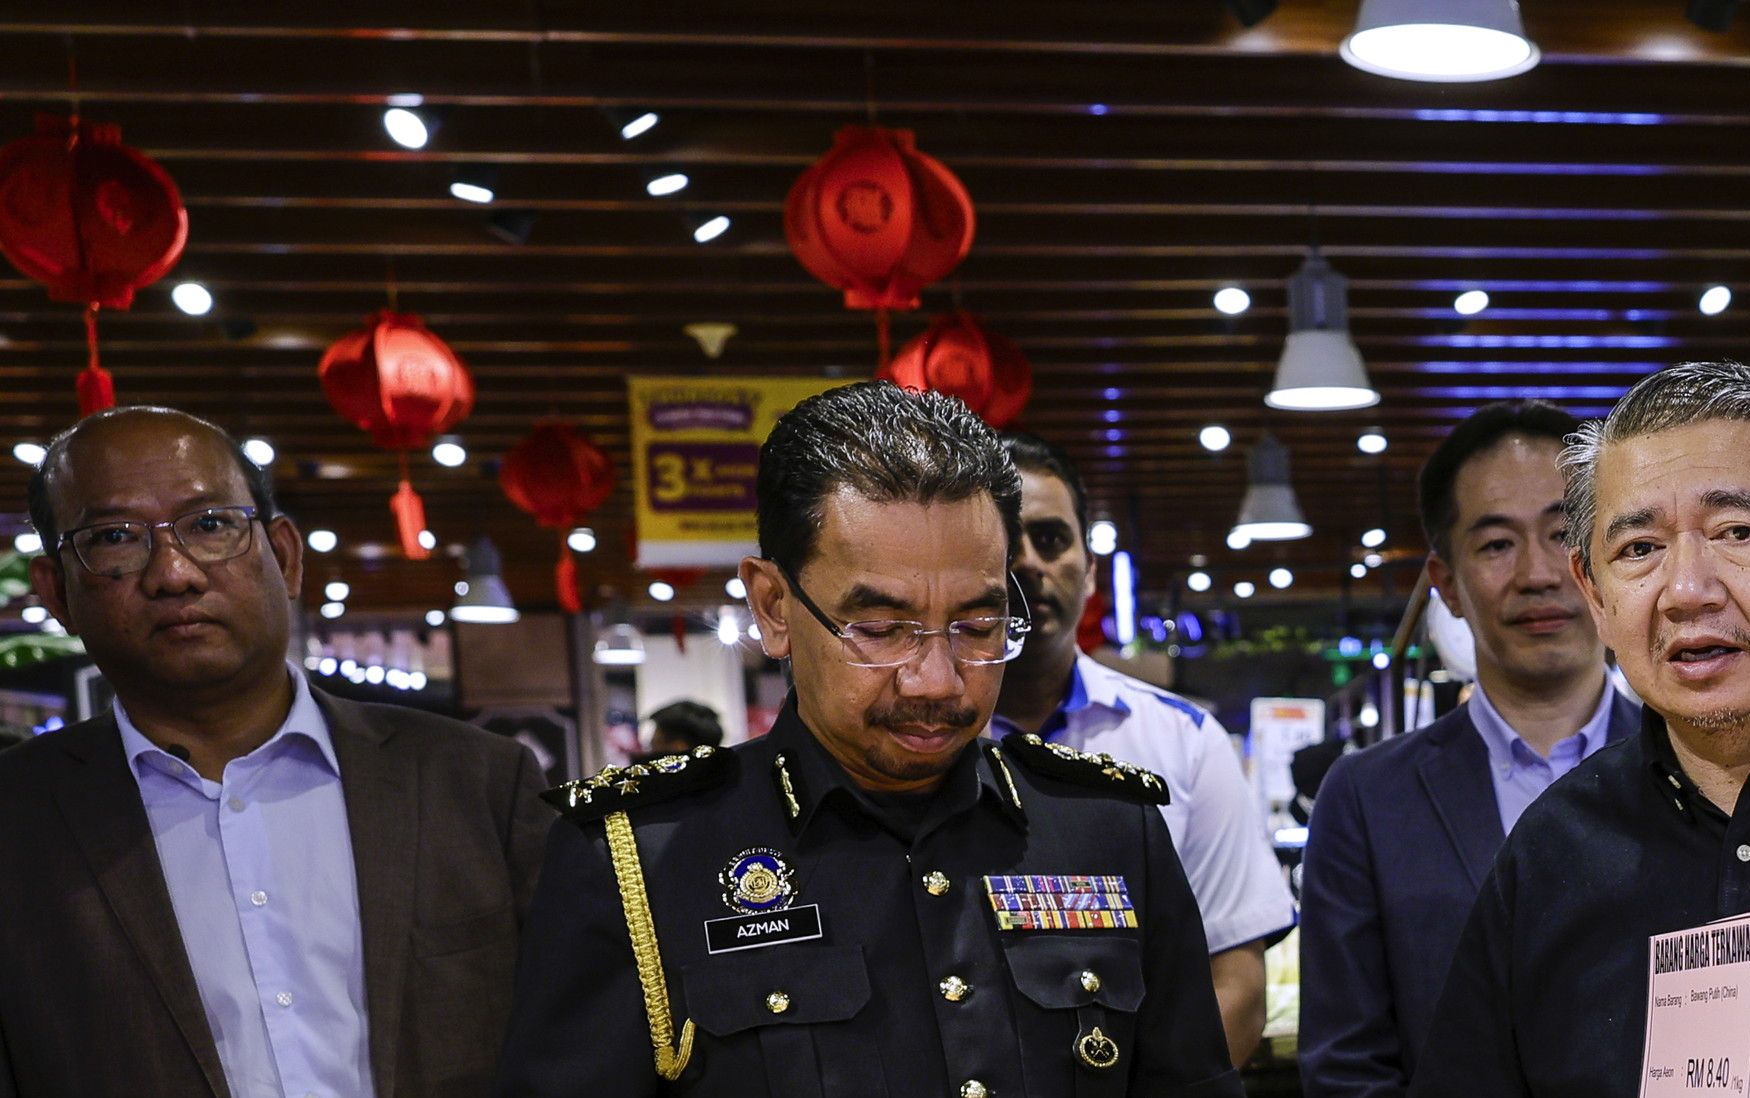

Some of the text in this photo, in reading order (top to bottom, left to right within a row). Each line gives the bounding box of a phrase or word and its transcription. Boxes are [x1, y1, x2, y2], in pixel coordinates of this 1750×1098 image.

[653, 452, 686, 499] 3
[737, 918, 790, 938] AZMAN
[1655, 935, 1683, 974] BARANG
[1684, 930, 1710, 970] HARGA
[1654, 995, 1667, 1007] Nama
[1667, 994, 1682, 1008] Barang
[1649, 1066, 1662, 1081] Harga
[1663, 1066, 1675, 1078] Aeon
[1686, 1058, 1705, 1088] RM
[1706, 1057, 1730, 1088] 8.40
